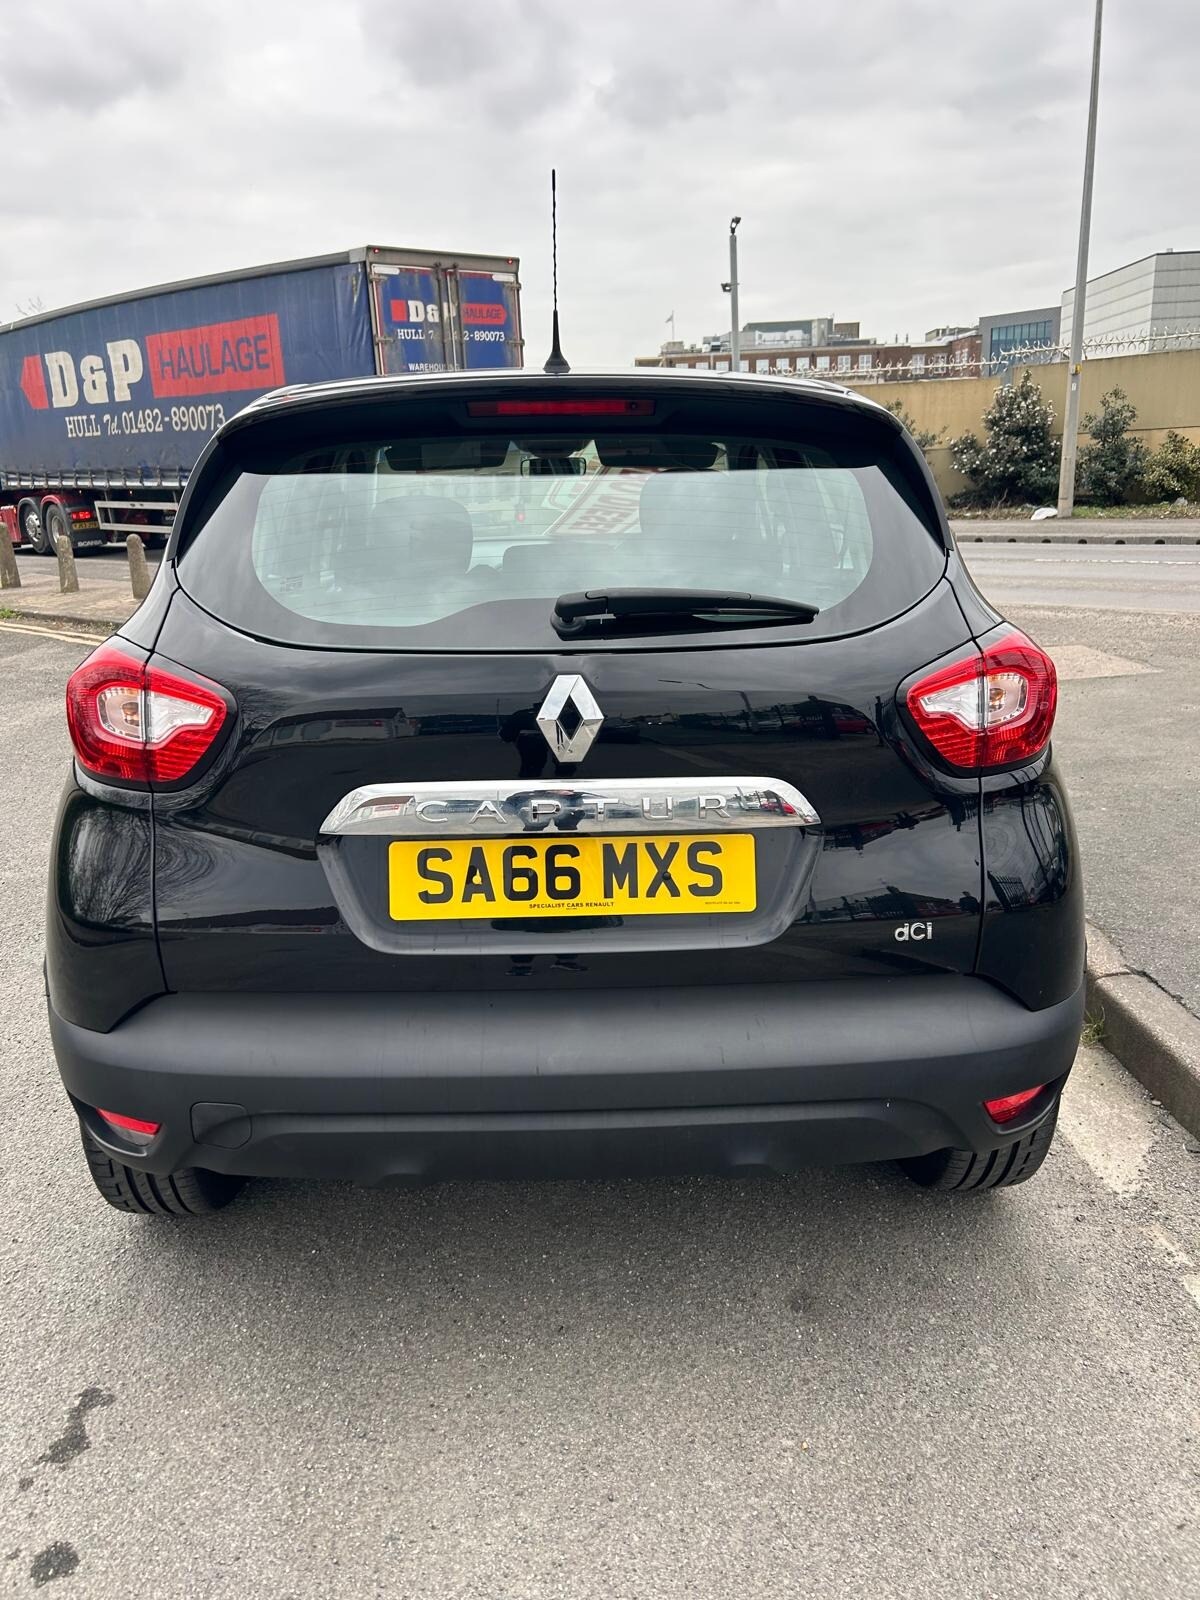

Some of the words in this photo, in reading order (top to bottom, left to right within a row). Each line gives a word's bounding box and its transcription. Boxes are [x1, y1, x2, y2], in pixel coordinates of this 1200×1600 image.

[398, 328, 426, 340] HULL
[45, 338, 143, 409] D&P
[159, 334, 270, 381] HAULAGE
[65, 414, 101, 438] HULL
[122, 403, 226, 435] 01482-890073
[415, 795, 730, 824] CAPTUR
[416, 843, 581, 905] SA66
[602, 840, 724, 899] MXS
[894, 922, 932, 941] dCi
